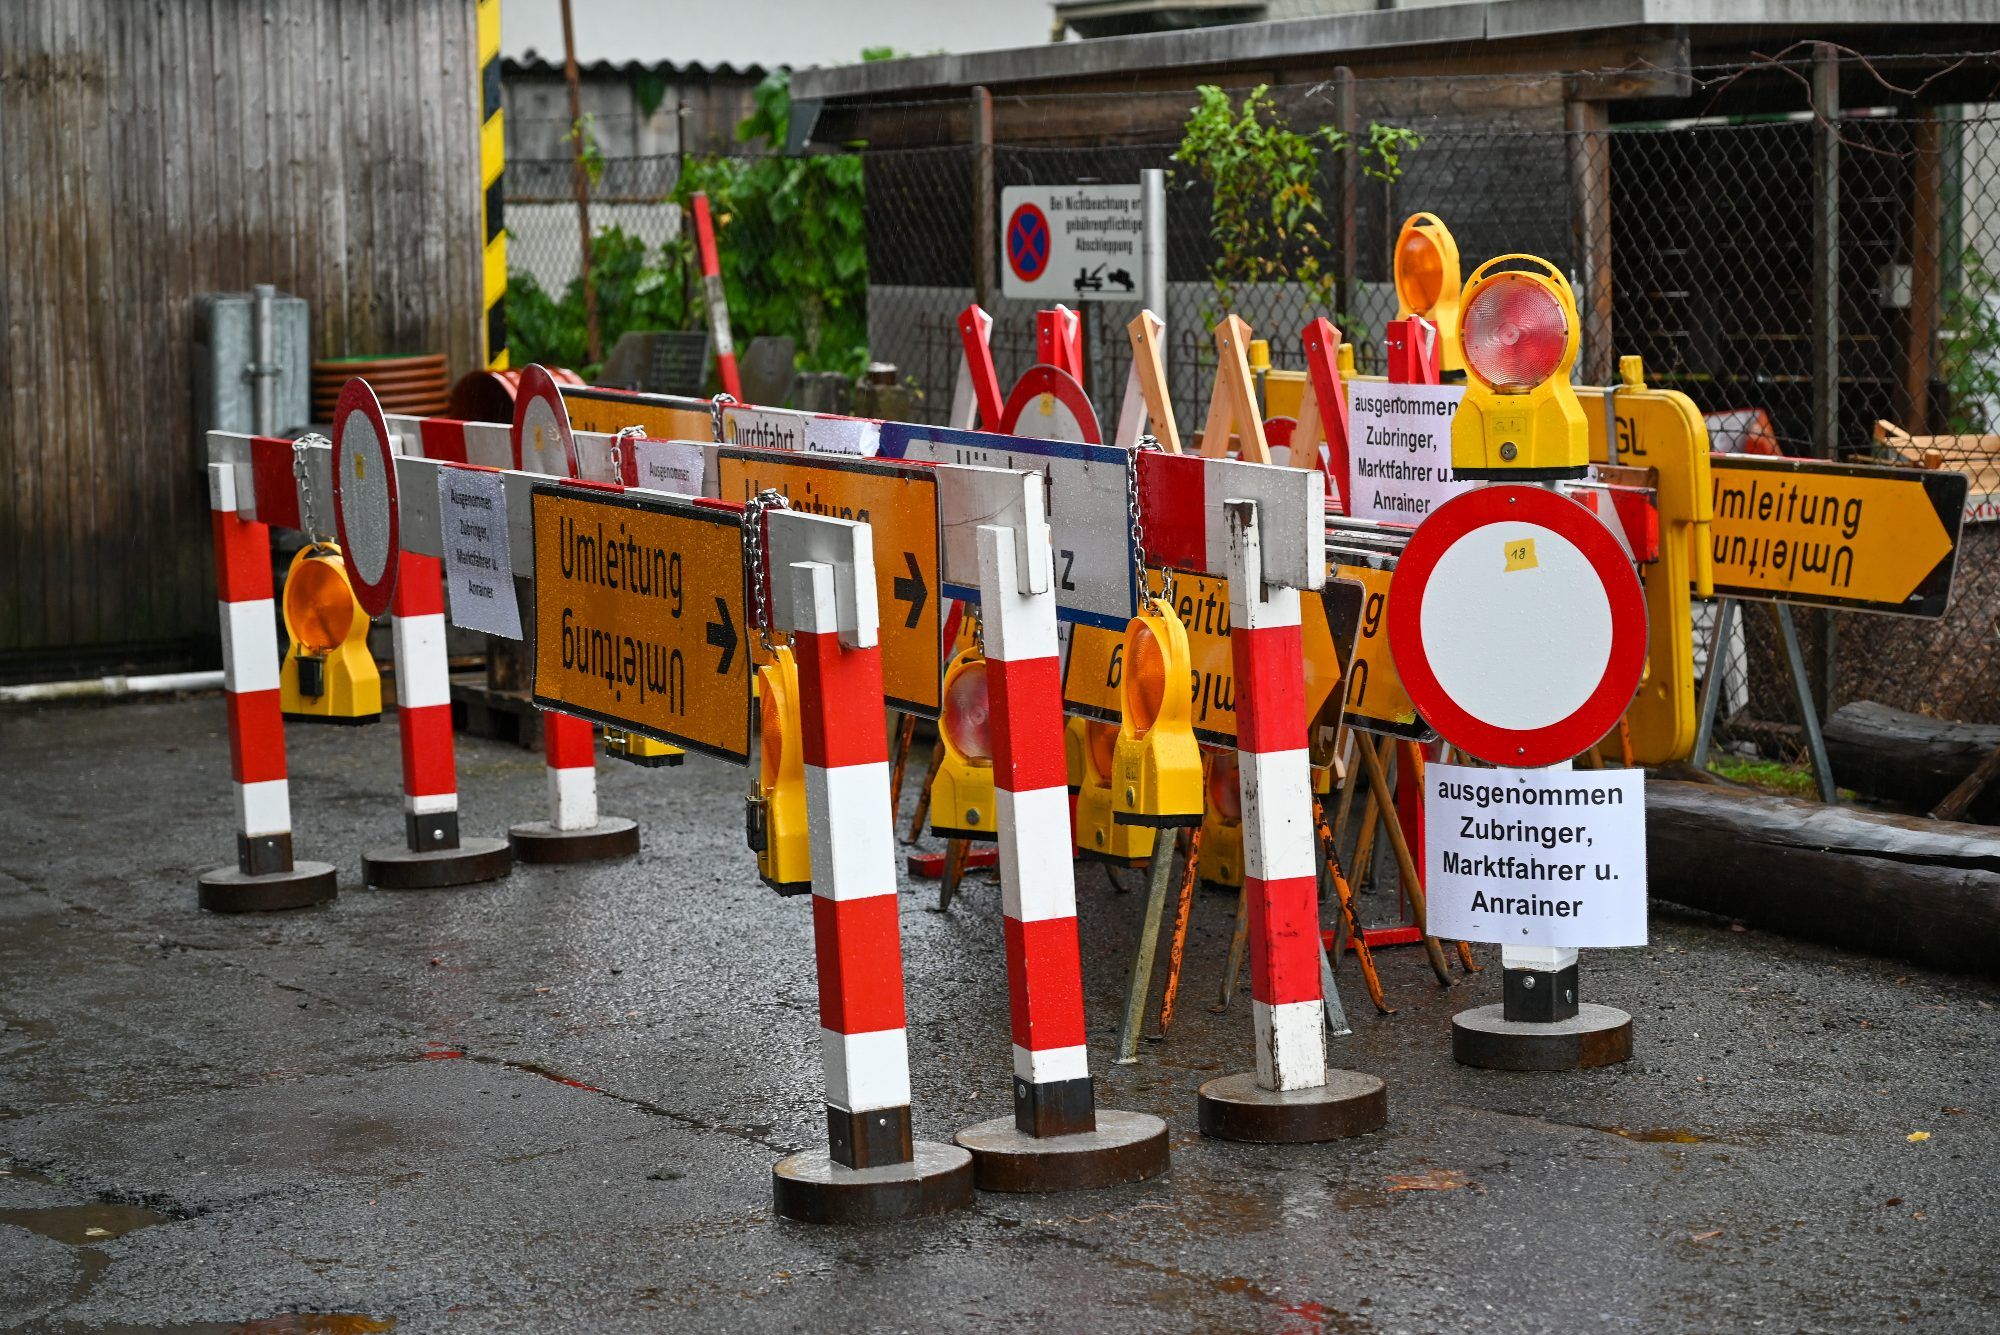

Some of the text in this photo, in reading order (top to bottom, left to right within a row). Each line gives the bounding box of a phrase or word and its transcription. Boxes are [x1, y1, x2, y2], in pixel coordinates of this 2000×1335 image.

[1050, 196, 1063, 210] Bei
[1075, 237, 1132, 255] Abschleppung
[1355, 396, 1458, 418] ausgenommen
[1366, 426, 1437, 453] Zubringer,
[1358, 457, 1432, 482] Marktfahrer
[450, 489, 493, 510] Ausgenommen
[1373, 490, 1430, 513] Anrainer
[559, 516, 683, 618] Umleitung
[1713, 534, 1854, 588] Umleitun
[468, 579, 494, 599] Anrainer
[562, 607, 685, 717] Umleitung
[1438, 781, 1623, 808] ausgenommen
[1460, 816, 1593, 849] Zubringer,
[1443, 851, 1619, 881] Marktfahrer u.
[1471, 890, 1583, 917] Anrainer
